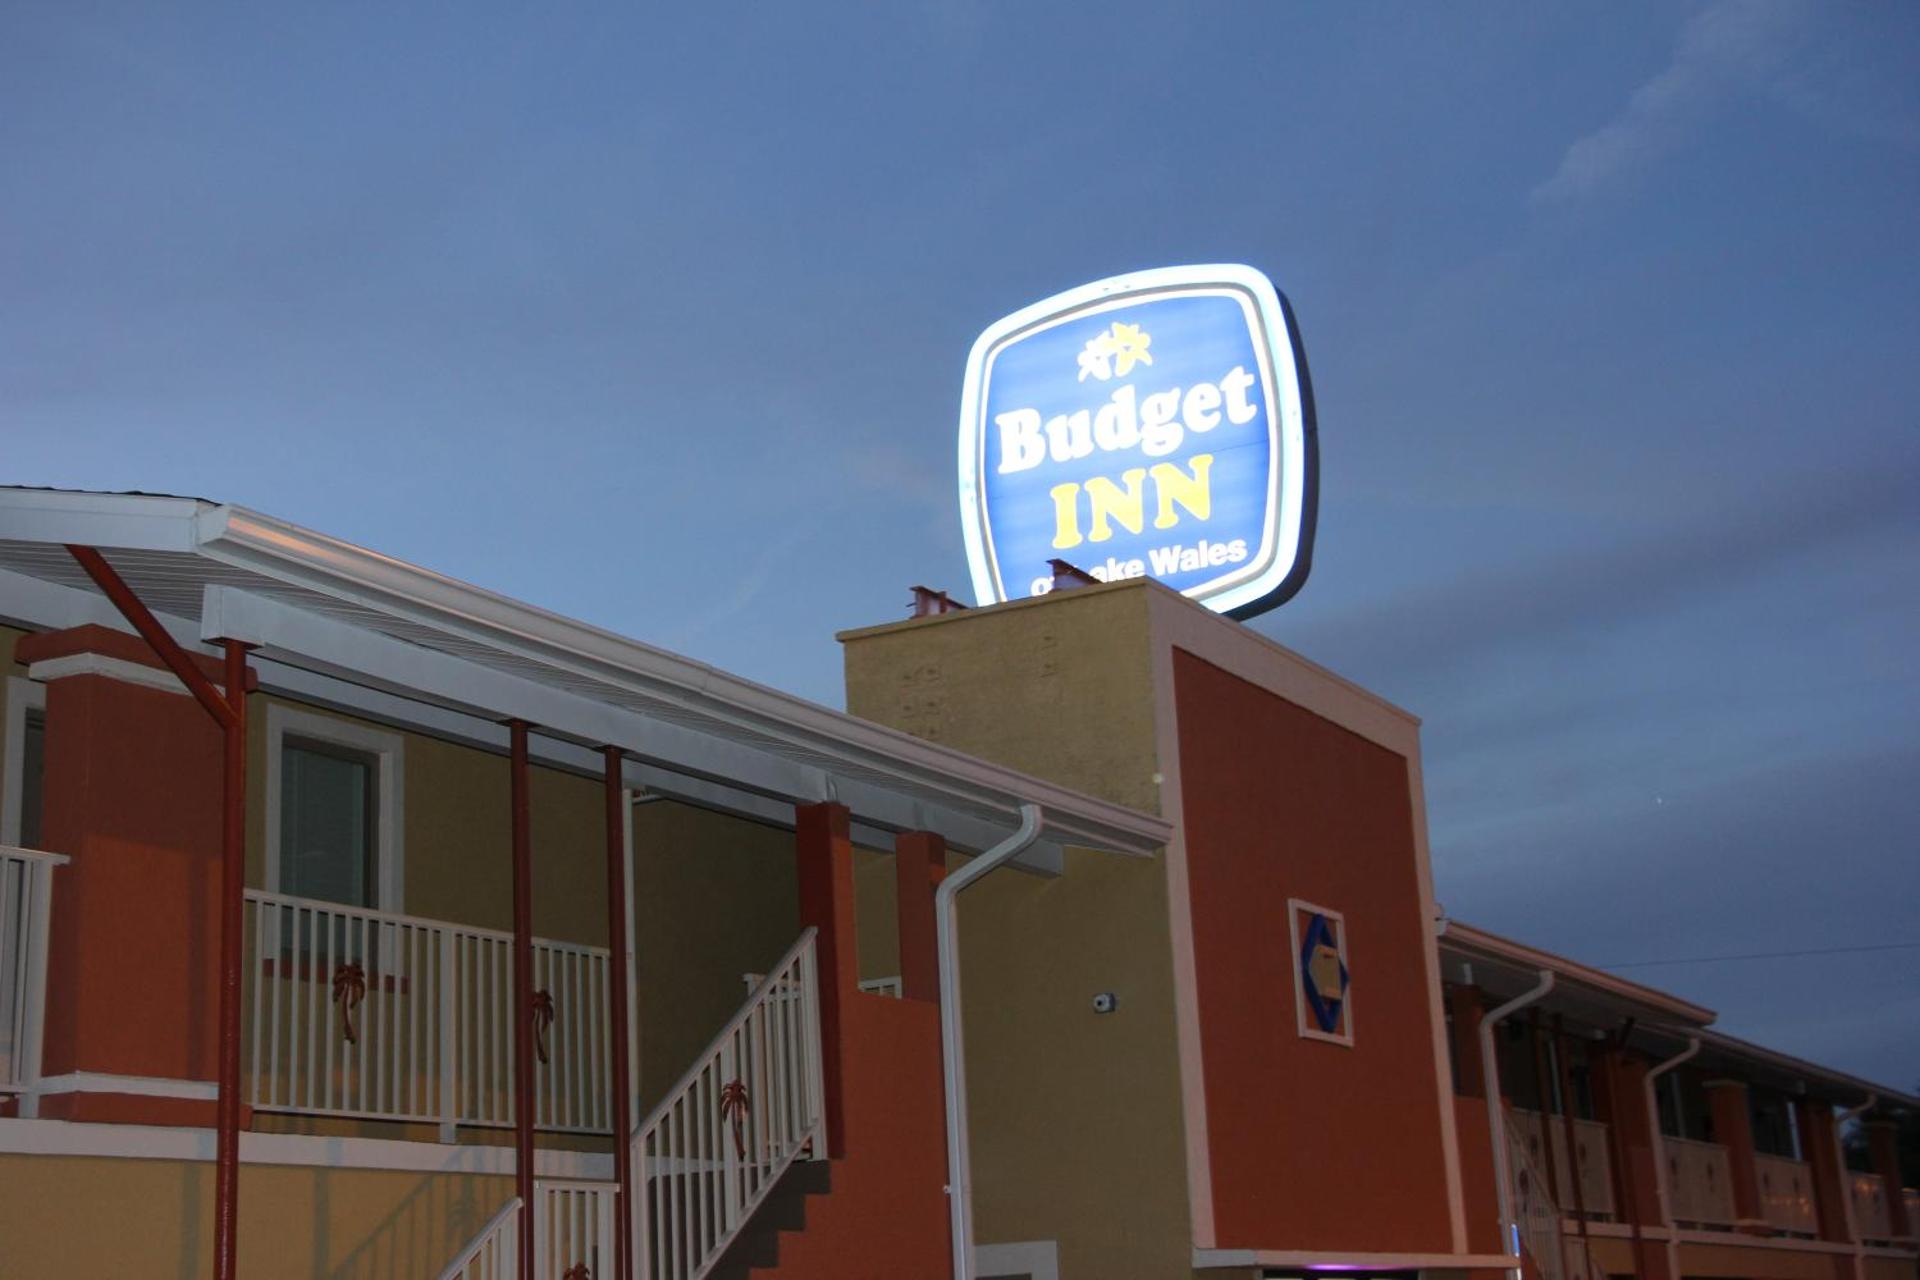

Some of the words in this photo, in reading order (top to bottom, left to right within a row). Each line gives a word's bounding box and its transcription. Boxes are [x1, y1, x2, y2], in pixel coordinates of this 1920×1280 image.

[994, 365, 1258, 474] Budget
[1050, 453, 1214, 549] INN
[1031, 577, 1055, 596] o
[1074, 557, 1145, 583] ake
[1148, 537, 1248, 577] Wales
